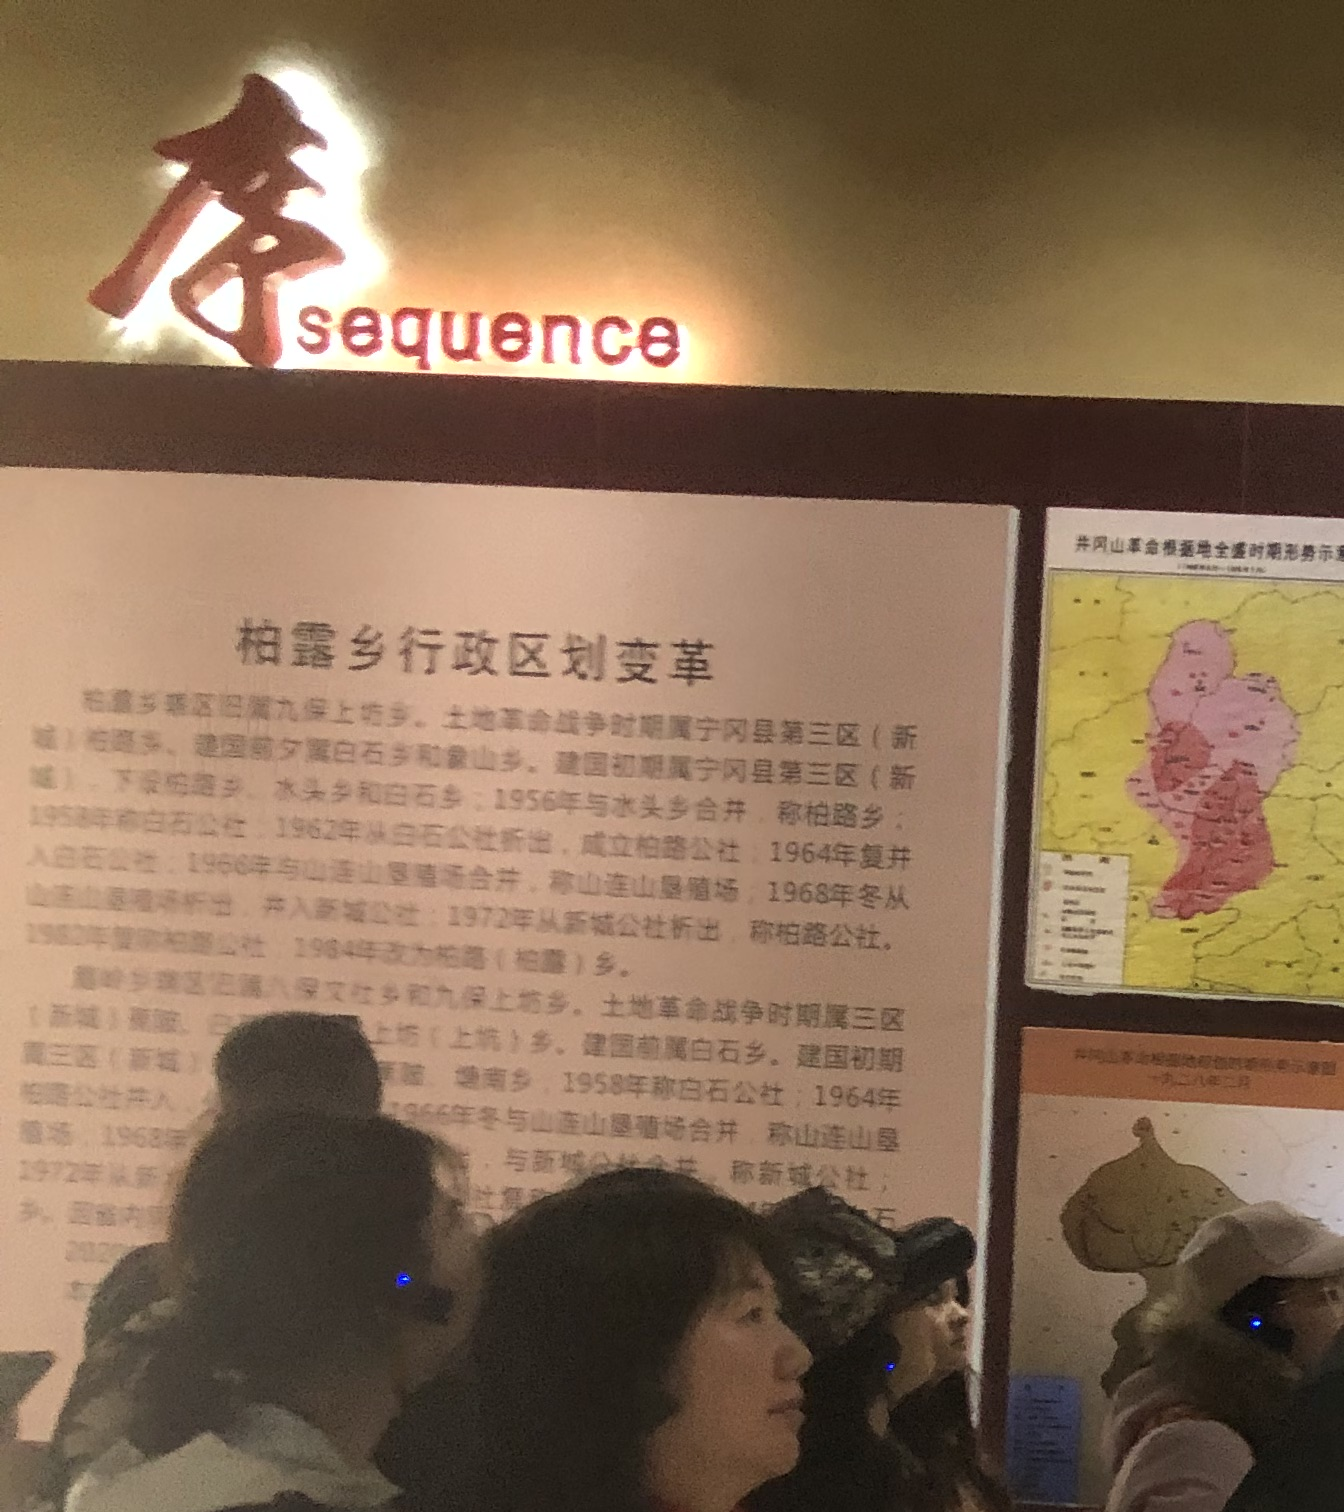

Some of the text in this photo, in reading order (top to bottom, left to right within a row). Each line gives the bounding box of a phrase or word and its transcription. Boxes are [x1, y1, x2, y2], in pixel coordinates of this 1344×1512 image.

[297, 303, 682, 370] sequence
[237, 619, 717, 685] 柏露乡行政区划变革
